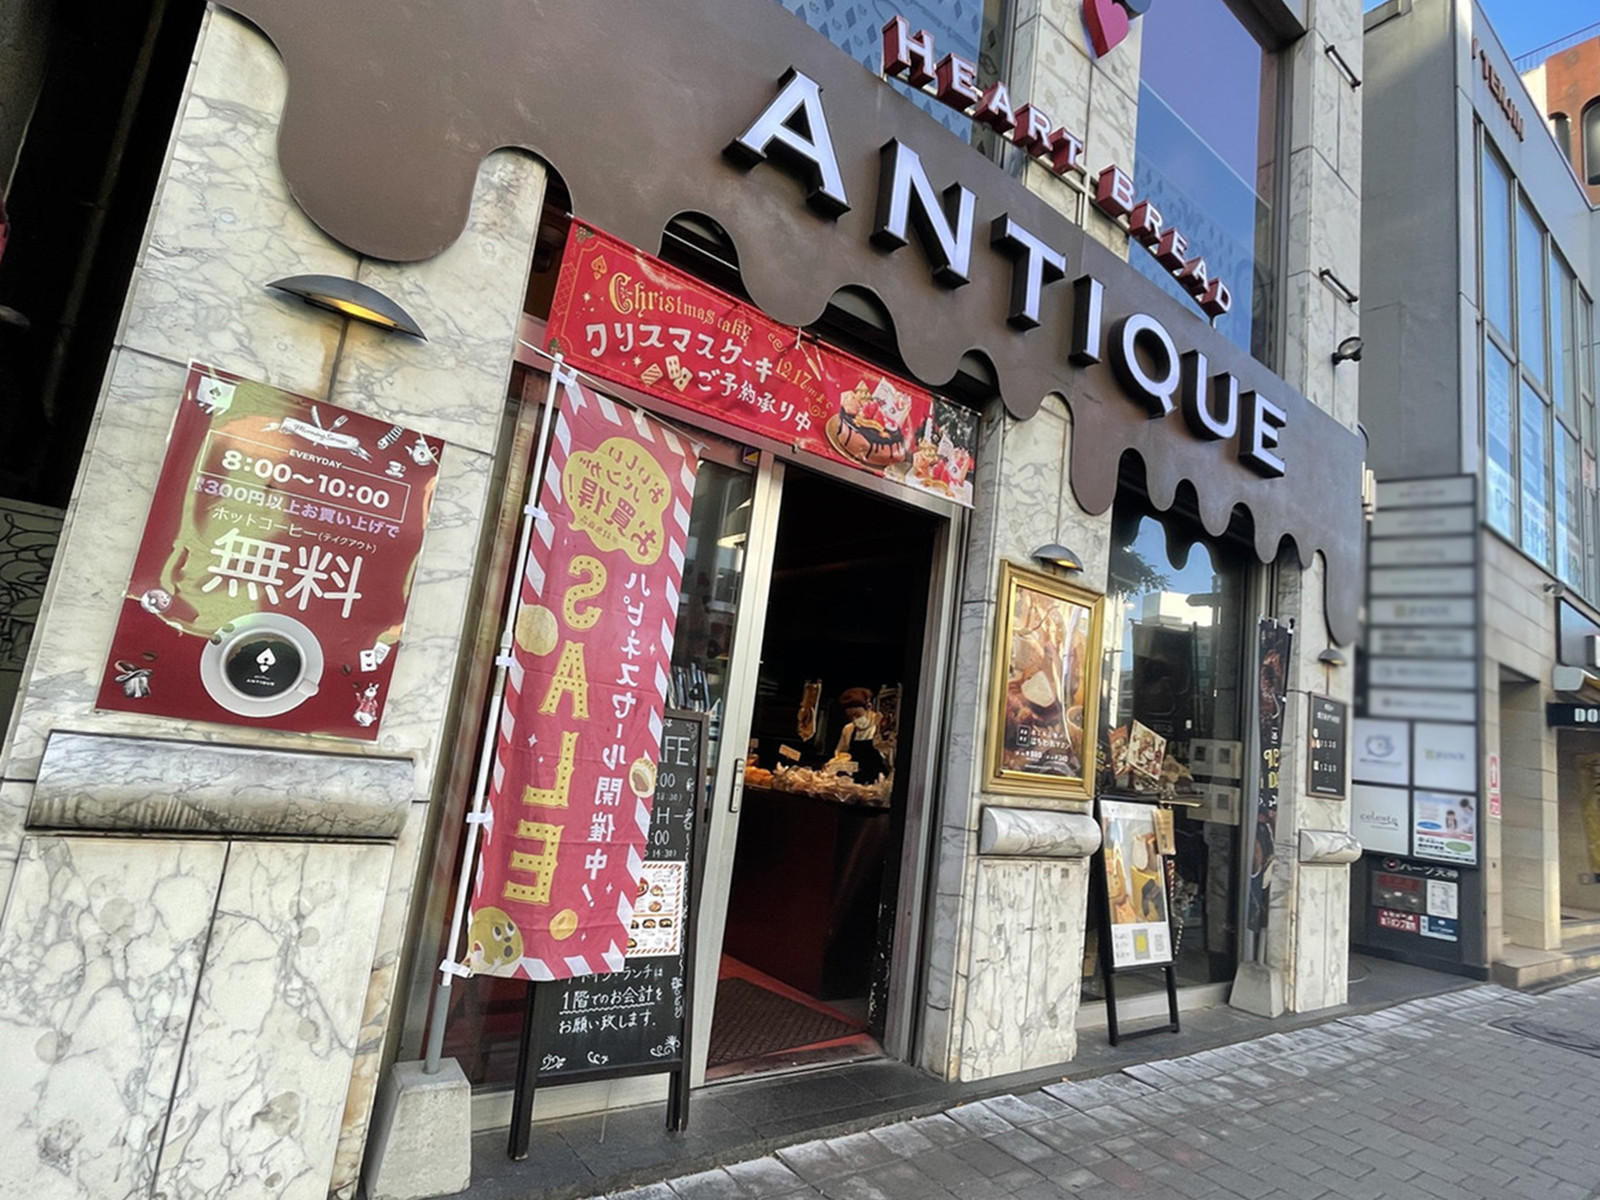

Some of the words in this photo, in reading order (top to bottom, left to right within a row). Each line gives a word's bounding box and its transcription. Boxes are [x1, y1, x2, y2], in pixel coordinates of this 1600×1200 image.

[886, 16, 1083, 172] HEART
[1101, 164, 1232, 315] BREAD
[608, 271, 716, 326] Christmas
[728, 66, 1288, 478] ANTIQUE
[585, 322, 773, 384] クリスマスケーキ
[697, 368, 812, 433] ご予約承り中
[289, 448, 342, 469] EVERYDAY
[201, 527, 363, 620] 無料
[561, 985, 664, 1010] 1階でのお会計を
